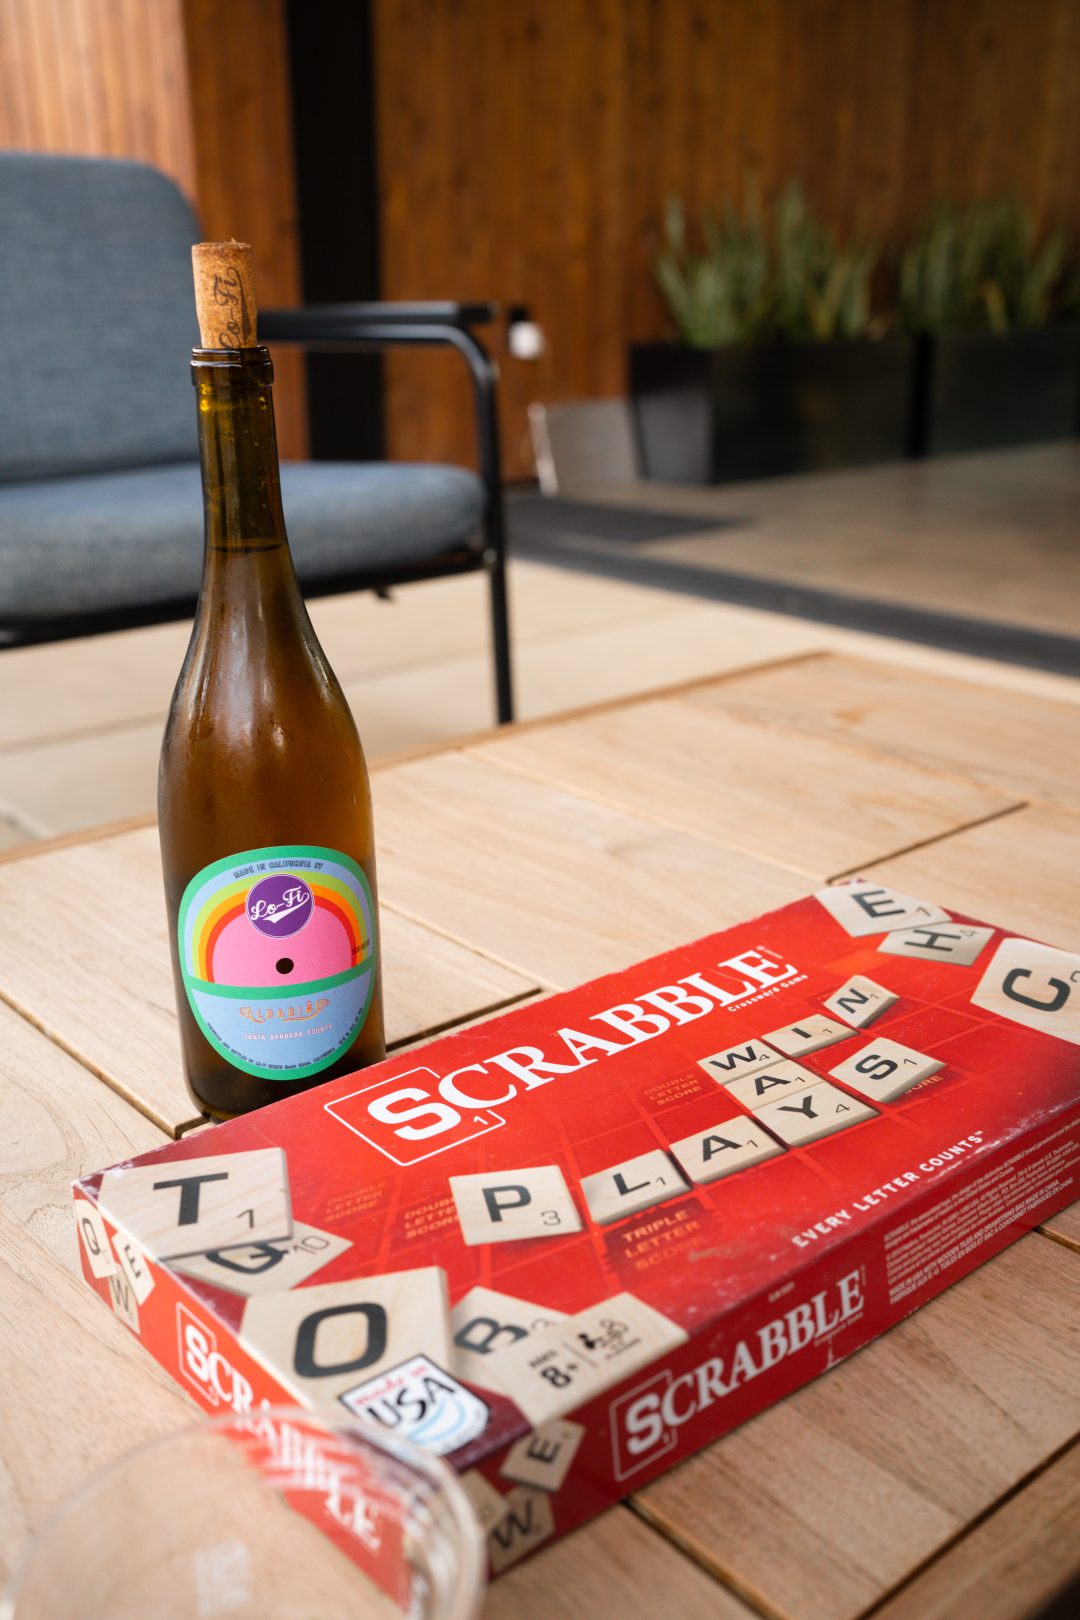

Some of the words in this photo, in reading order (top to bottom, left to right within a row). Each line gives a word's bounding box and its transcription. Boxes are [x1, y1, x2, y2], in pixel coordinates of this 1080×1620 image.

[250, 885, 310, 920] Lo-Fi
[851, 890, 907, 918] E
[904, 929, 961, 952] H
[727, 987, 780, 1012] Crossword
[780, 974, 808, 989] Game
[1002, 968, 1071, 1012] C
[307, 1024, 333, 1035] COUNTY
[367, 950, 799, 1141] SCRABBLE
[708, 1045, 759, 1073] W
[791, 1027, 813, 1040] I
[836, 988, 869, 1014] N
[650, 1080, 699, 1100] LETTER
[657, 1086, 702, 1105] SCORE
[753, 1073, 790, 1096] A
[904, 1075, 944, 1094] ORE
[472, 1114, 487, 1126] 1
[481, 1185, 532, 1223] P
[612, 1172, 650, 1196] L
[702, 1135, 743, 1162] A
[777, 1095, 818, 1119] Y
[855, 1054, 898, 1080] S
[153, 1172, 228, 1226] T
[404, 1197, 455, 1220] DOUB
[791, 1209, 852, 1249] EVERY
[852, 1171, 921, 1212] LETTER
[236, 1208, 255, 1229] 1
[405, 1205, 456, 1229] LETTE
[540, 1210, 561, 1227] 3
[622, 1210, 689, 1242] TRIPLE
[625, 1221, 700, 1258] LETTER
[293, 1303, 387, 1378] O
[625, 1269, 864, 1455] SCRABBLE
[367, 1376, 456, 1429] USA
